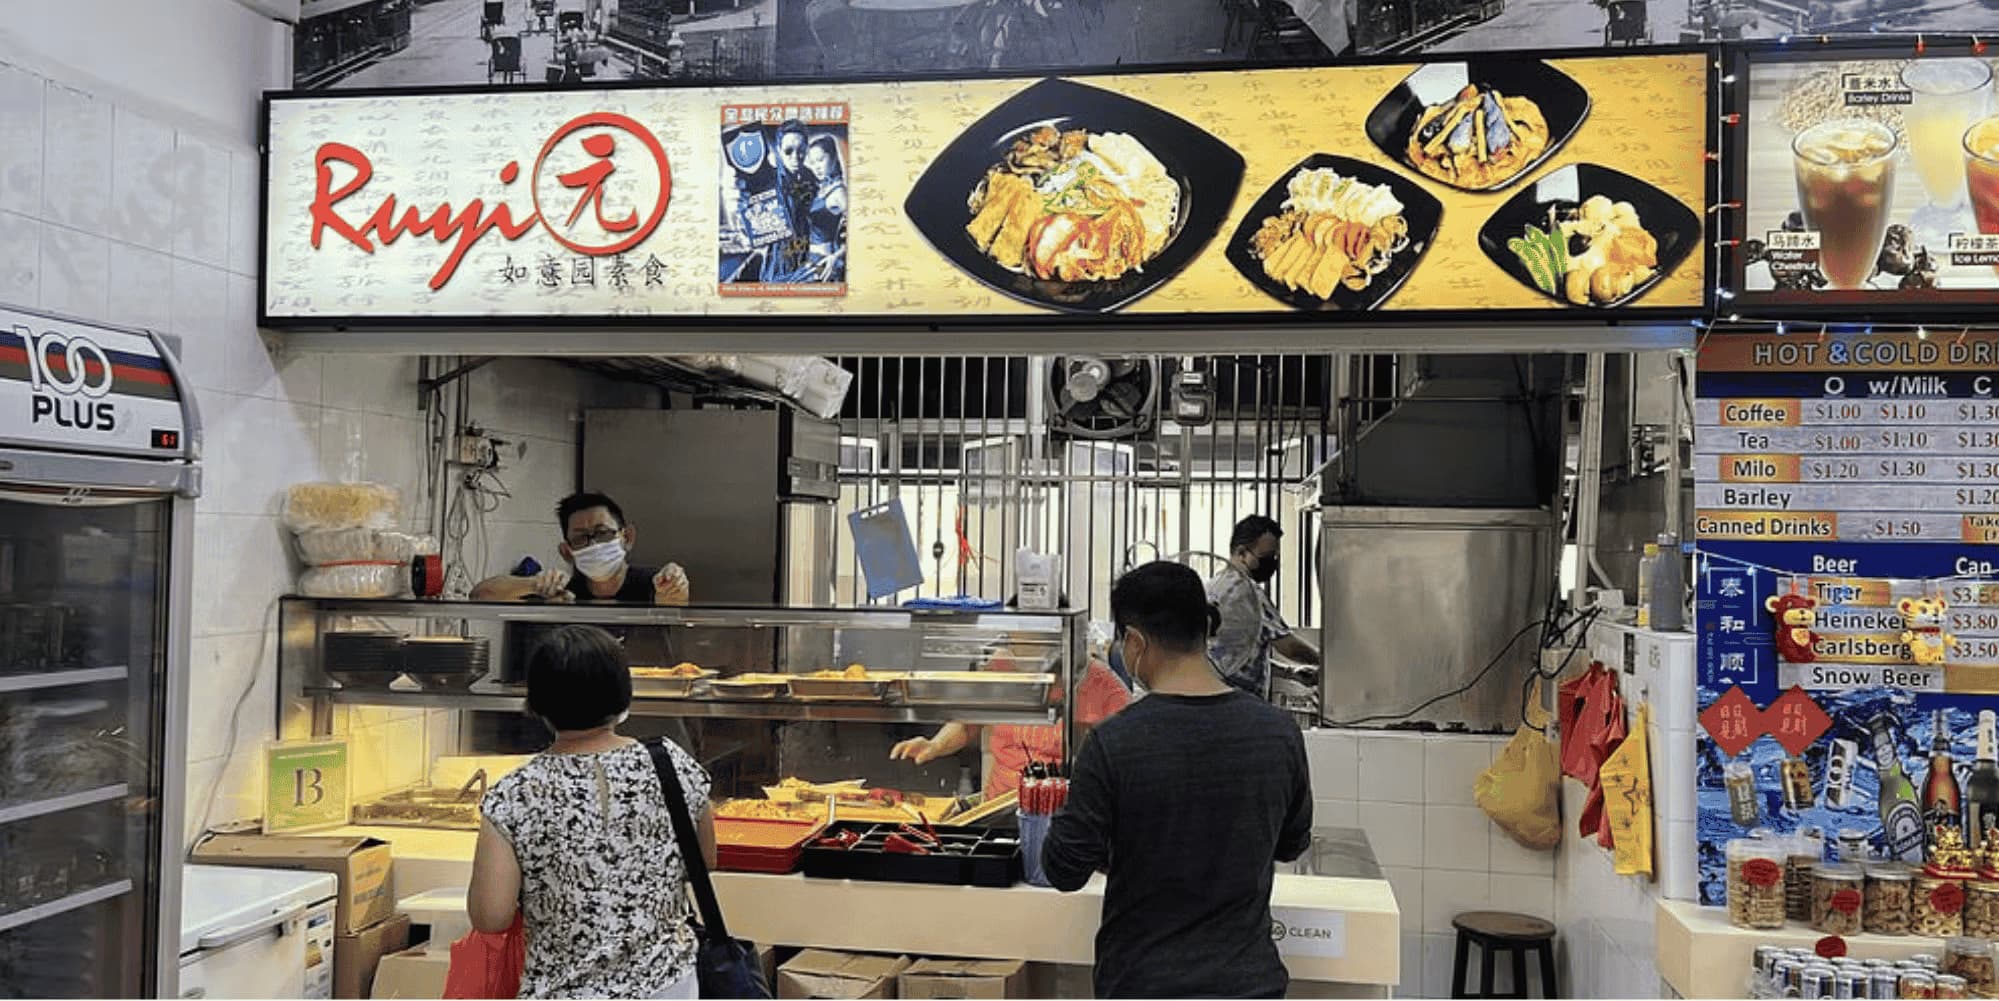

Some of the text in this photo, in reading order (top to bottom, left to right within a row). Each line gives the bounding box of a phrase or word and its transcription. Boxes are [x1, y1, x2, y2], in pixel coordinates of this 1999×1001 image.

[556, 134, 638, 233] 元
[309, 142, 538, 291] Ruyi
[499, 254, 668, 287] 如意园素食
[13, 324, 113, 399] 100
[1754, 341, 1819, 365] HOT
[1824, 375, 1992, 396] O w/Milk C
[32, 395, 116, 432] PLUS
[1726, 404, 1785, 421] Coffee
[1815, 403, 1860, 419] $1.00
[1879, 403, 1926, 420] $1.10
[1738, 432, 1769, 448] Tea
[1814, 432, 1861, 450] $1.00
[1881, 431, 1928, 448] $1.10
[1734, 460, 1776, 477] Milo
[1813, 462, 1859, 478] $1.20
[1879, 460, 1926, 477] $1.30
[1724, 488, 1792, 509] Barley
[1697, 518, 1922, 536] Canned Drinks $1.50
[1813, 554, 1992, 575] Beer Can
[1815, 583, 1862, 604] Tiger
[1952, 613, 1998, 630] $3.80
[1813, 638, 1998, 660] Carlsberg $3.50
[1813, 666, 1930, 686] Snow Beer
[1290, 926, 1332, 939] CLEAN
